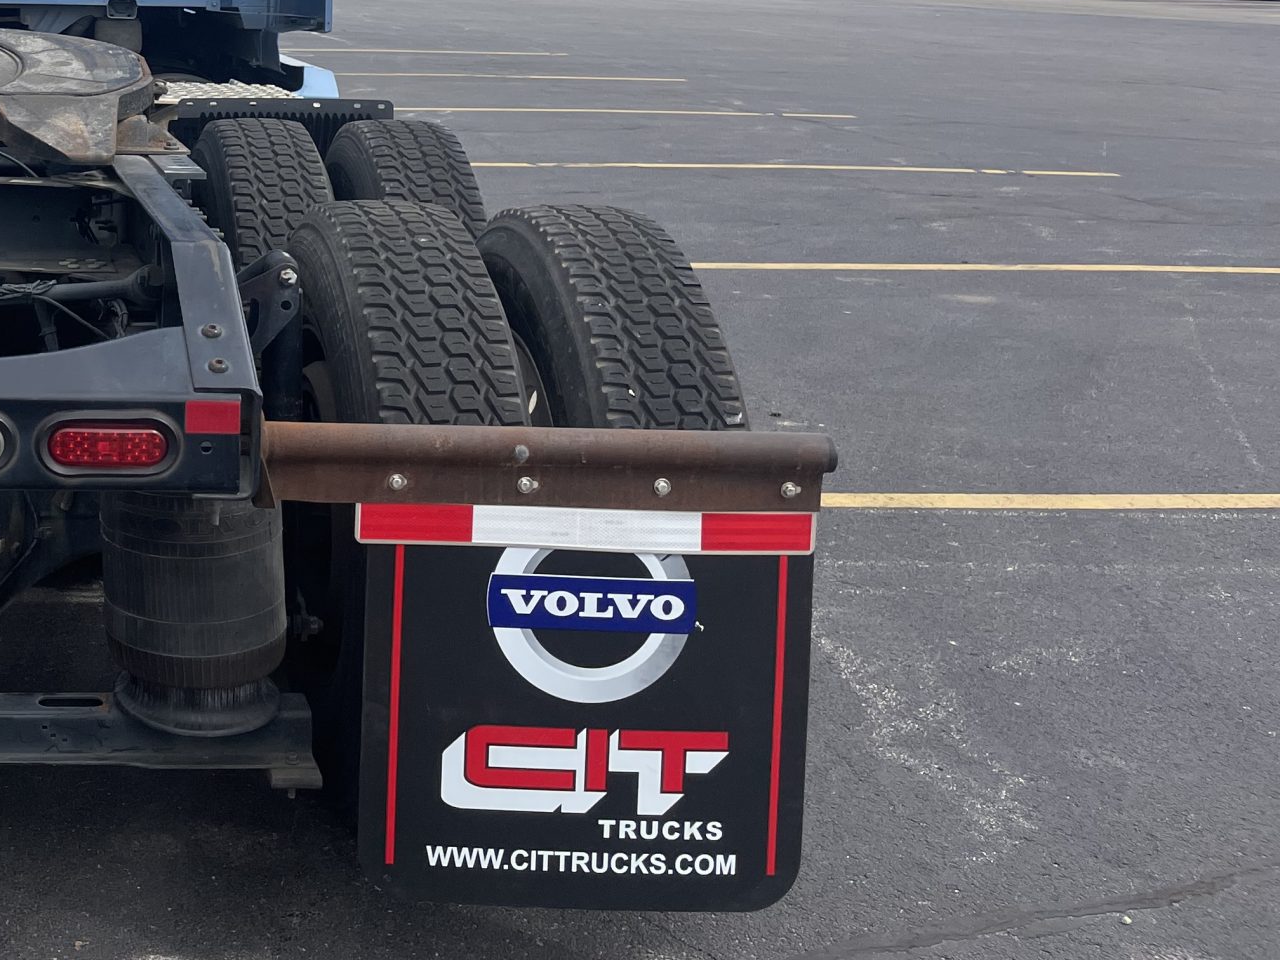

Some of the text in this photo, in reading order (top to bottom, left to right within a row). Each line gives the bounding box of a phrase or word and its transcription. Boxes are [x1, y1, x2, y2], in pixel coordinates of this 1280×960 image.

[500, 588, 686, 621] VOLVO
[440, 724, 730, 816] CIT
[597, 818, 724, 841] TRUCKS
[425, 844, 738, 877] WWW.CITTRUCKS.COM
